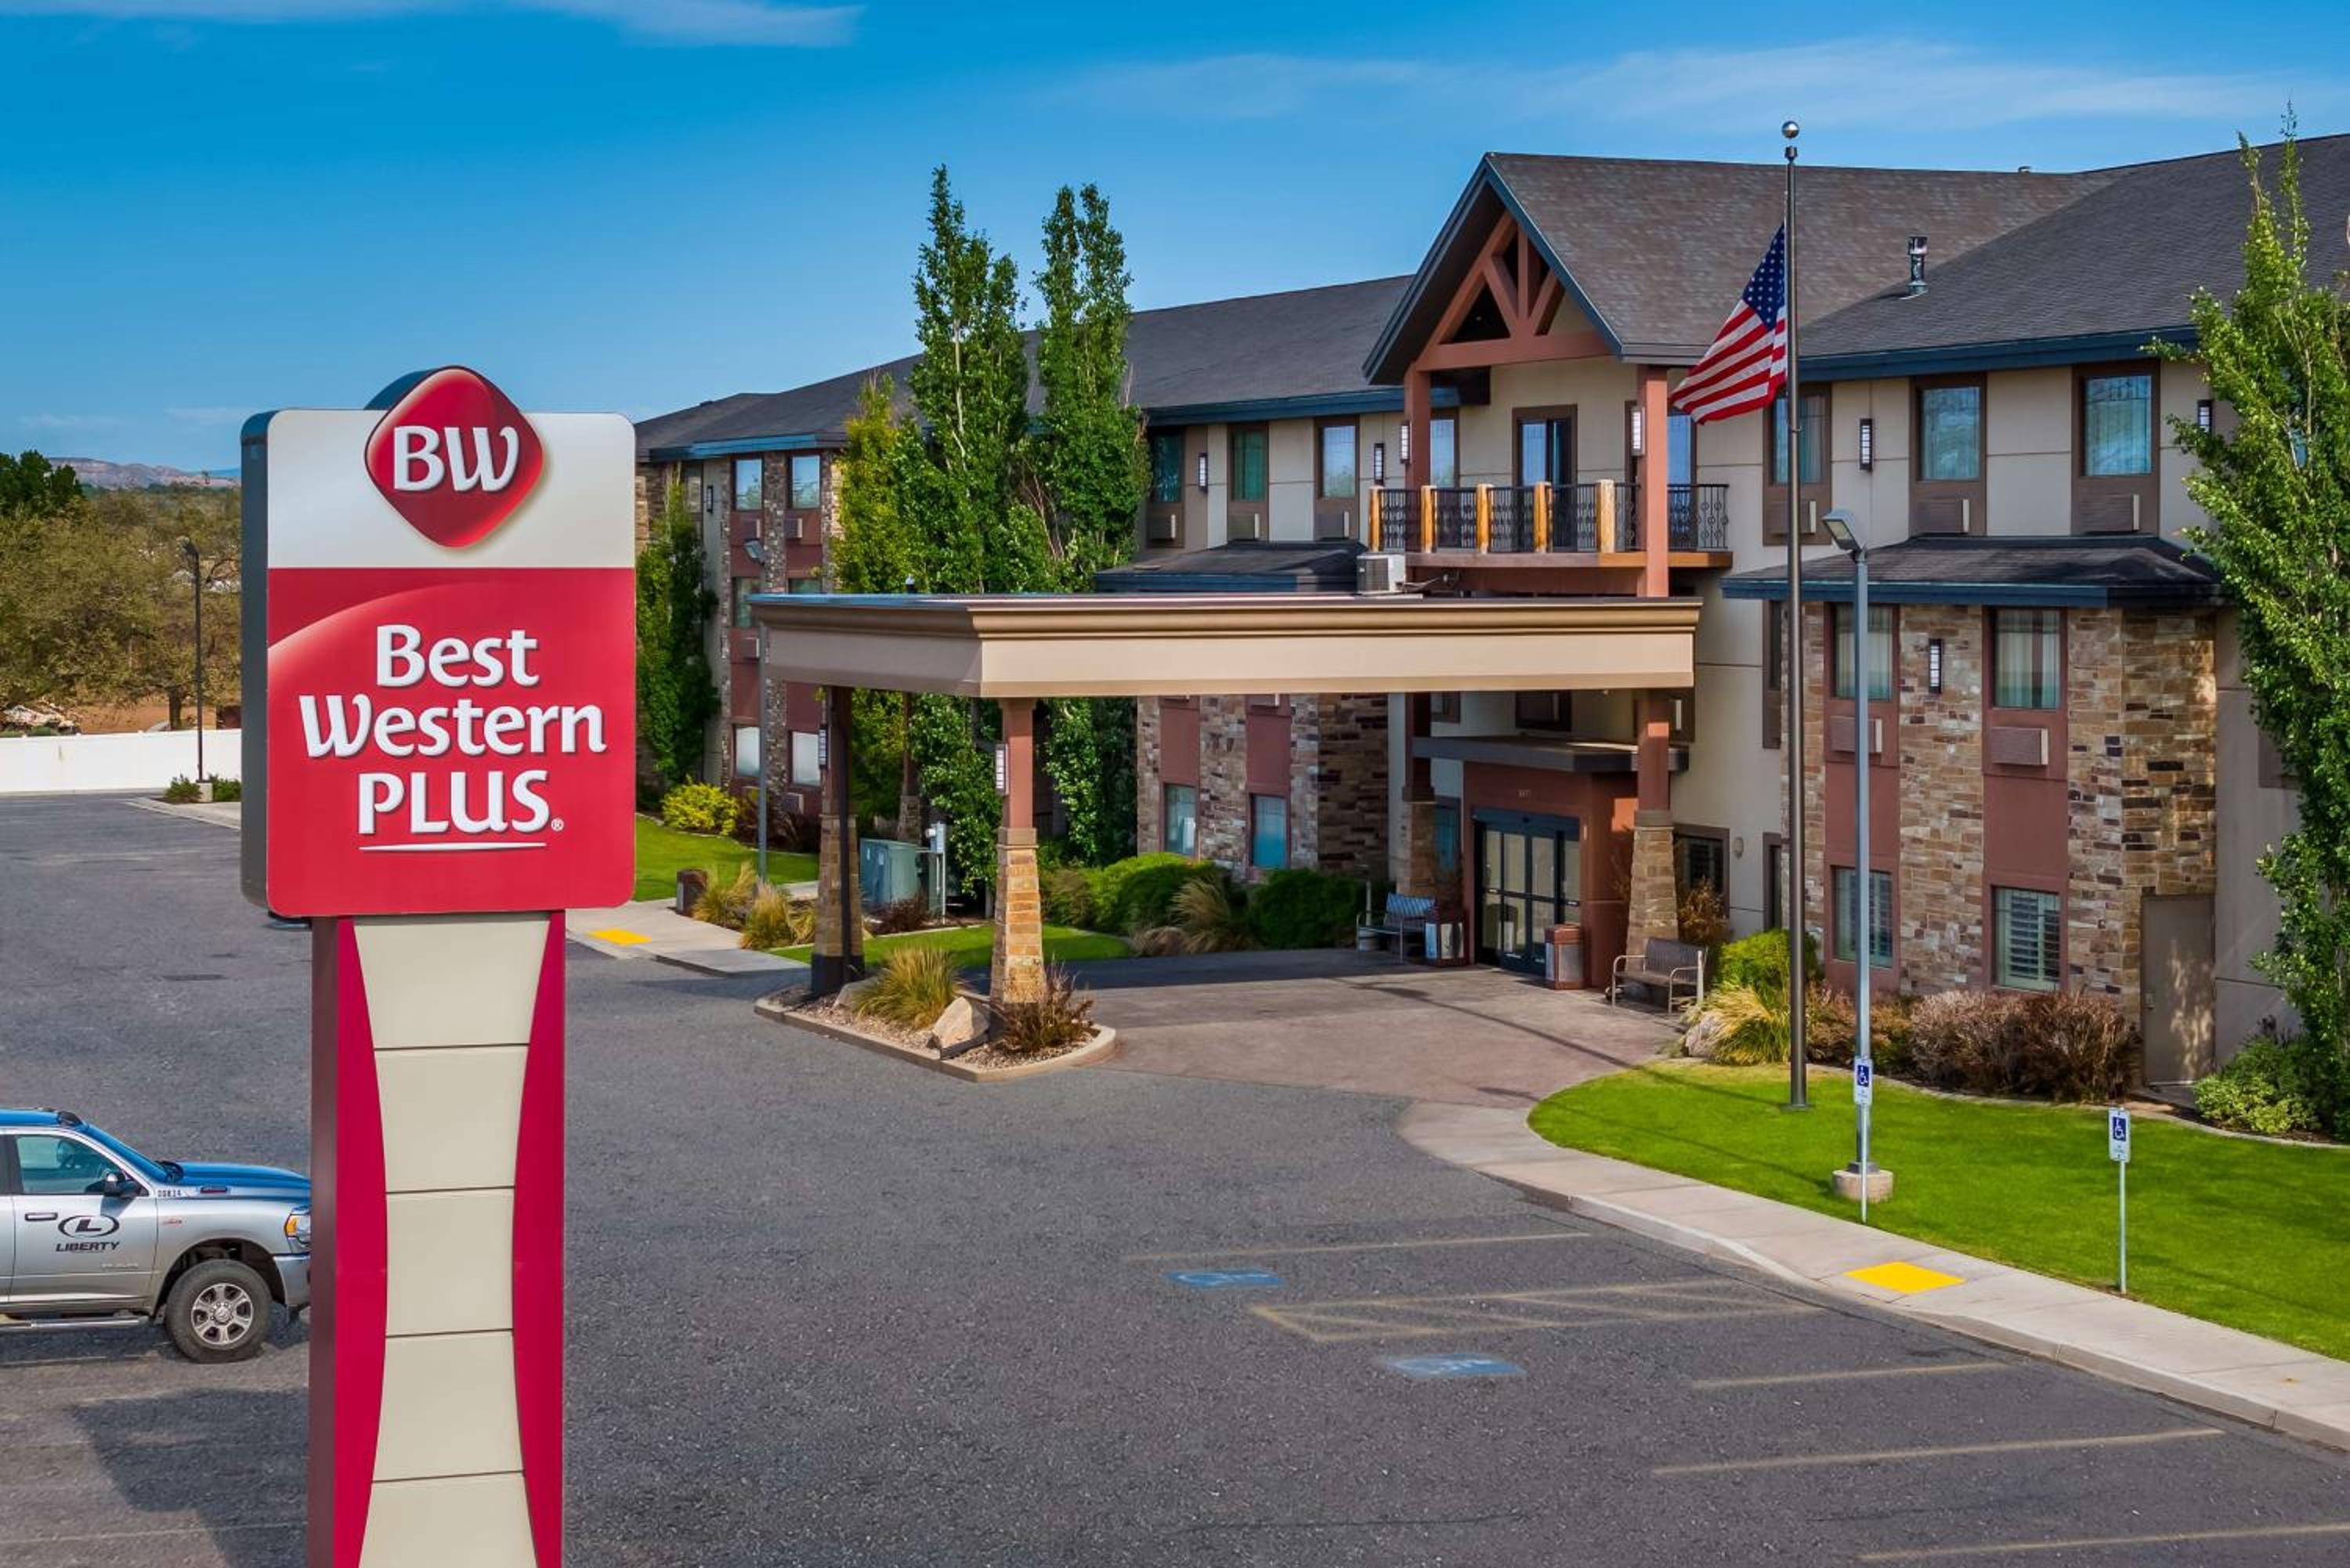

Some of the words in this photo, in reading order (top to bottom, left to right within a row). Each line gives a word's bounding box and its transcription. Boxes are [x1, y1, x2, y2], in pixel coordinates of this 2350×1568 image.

[393, 426, 519, 492] BW
[377, 624, 540, 687] Best
[299, 694, 607, 757] Western
[56, 1241, 121, 1252] LIBERTY
